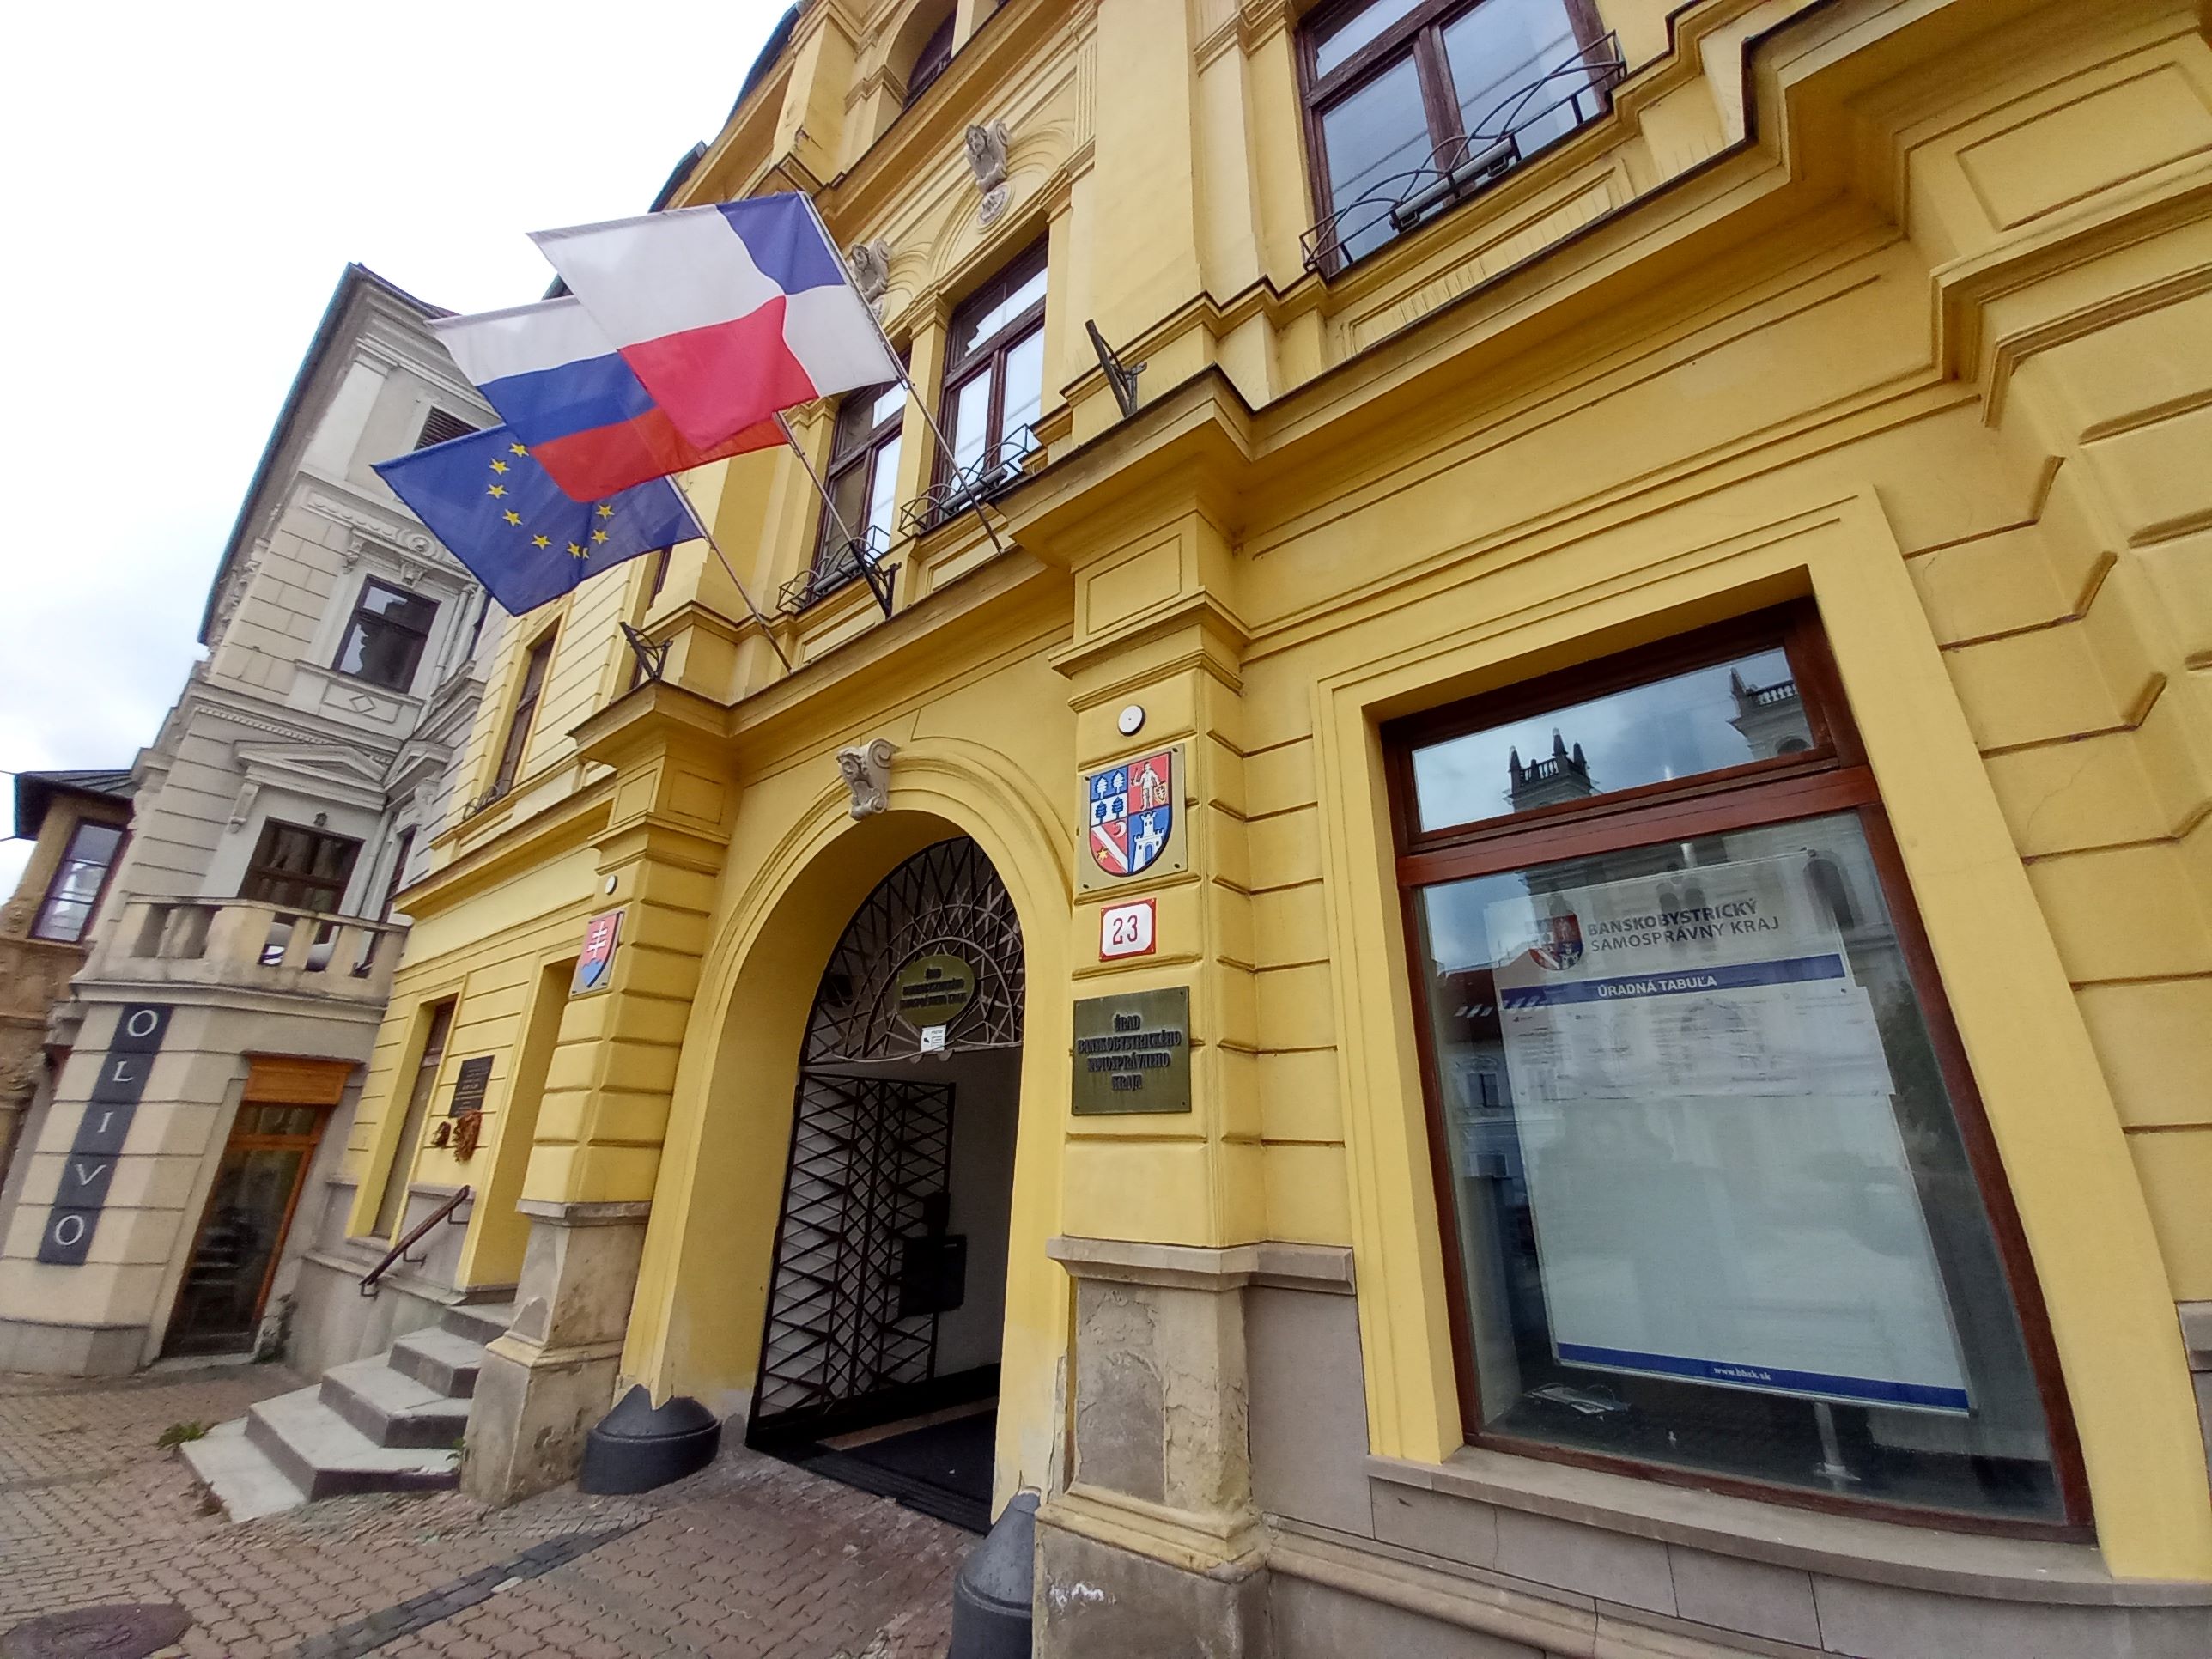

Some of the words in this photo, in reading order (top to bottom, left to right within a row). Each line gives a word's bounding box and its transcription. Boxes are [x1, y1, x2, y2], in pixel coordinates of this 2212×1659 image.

[1113, 915, 1138, 945] 23
[1588, 898, 1759, 936] BANSKOBYSTRICKÝ
[1591, 923, 1724, 952] SAMOSPRÁVNY
[1730, 915, 1779, 935] KRAJ
[1597, 979, 1657, 998] ÚRADNÁ
[1658, 975, 1717, 992] TABUĽA
[1114, 1013, 1141, 1031] ÚRAD
[55, 1009, 158, 1246] OLIVO
